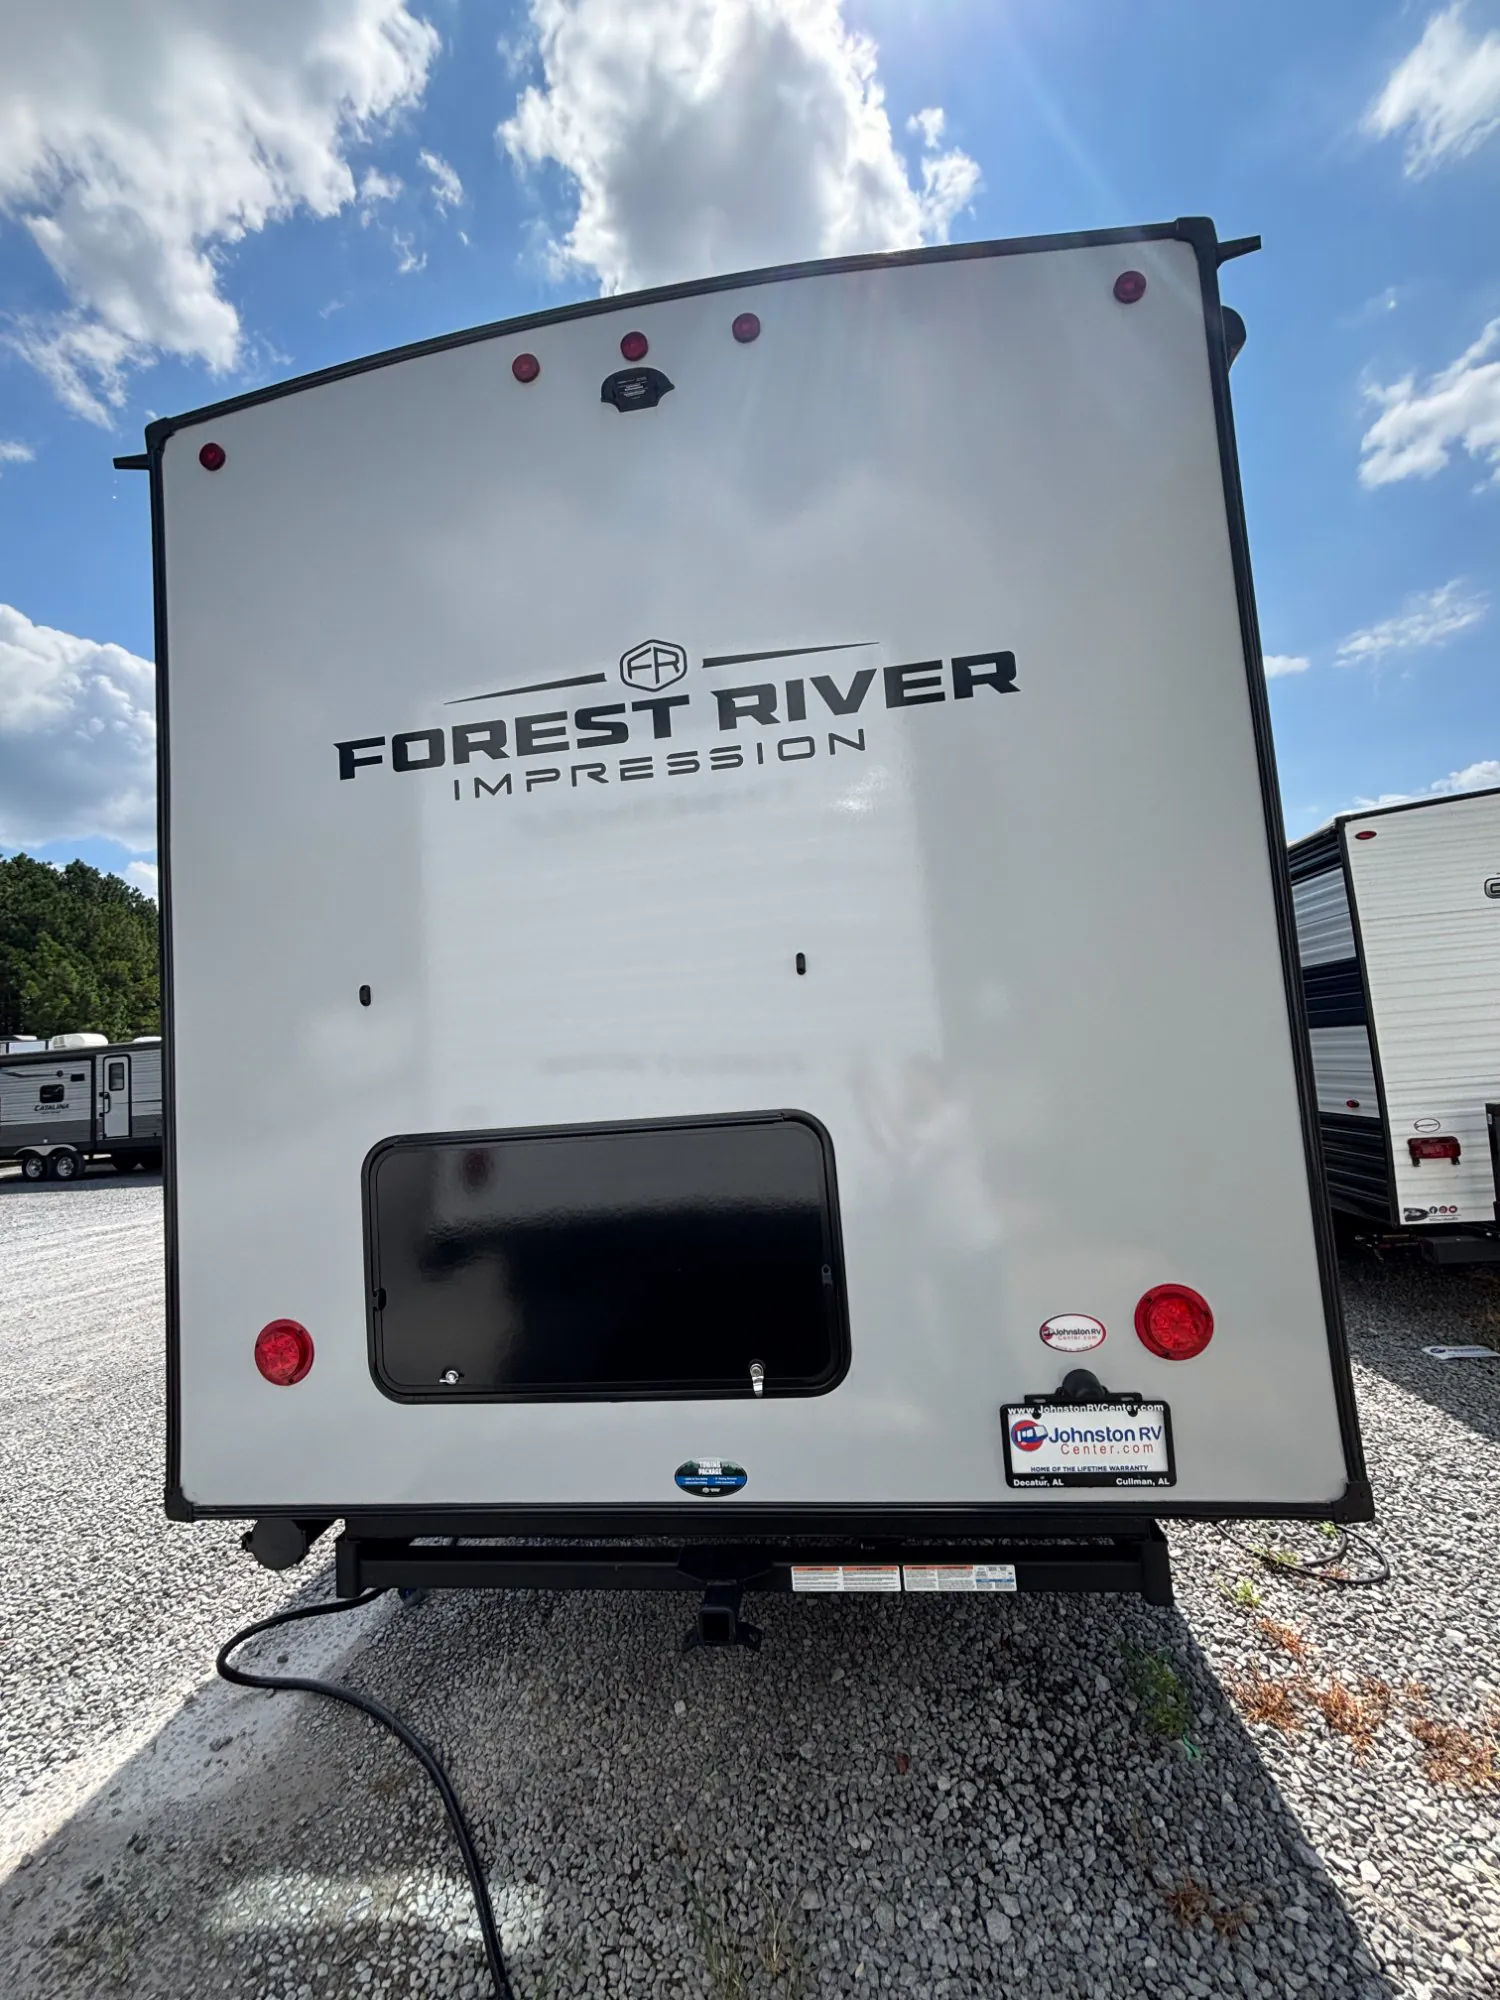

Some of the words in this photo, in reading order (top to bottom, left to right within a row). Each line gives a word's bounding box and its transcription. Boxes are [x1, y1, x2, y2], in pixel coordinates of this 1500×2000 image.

[625, 643, 682, 687] FR
[334, 694, 690, 779] FOREST
[711, 650, 1021, 731] RIVER
[453, 728, 867, 801] IMPRESSION
[1054, 1328, 1090, 1336] Johnston
[1049, 1426, 1136, 1443] Johnston
[1139, 1425, 1162, 1441] RV
[1060, 1443, 1154, 1455] Center.com
[1013, 1479, 1050, 1487] Decatur,
[1052, 1478, 1064, 1486] AL
[1116, 1477, 1156, 1486] Cullman,
[1158, 1477, 1170, 1485] AL
